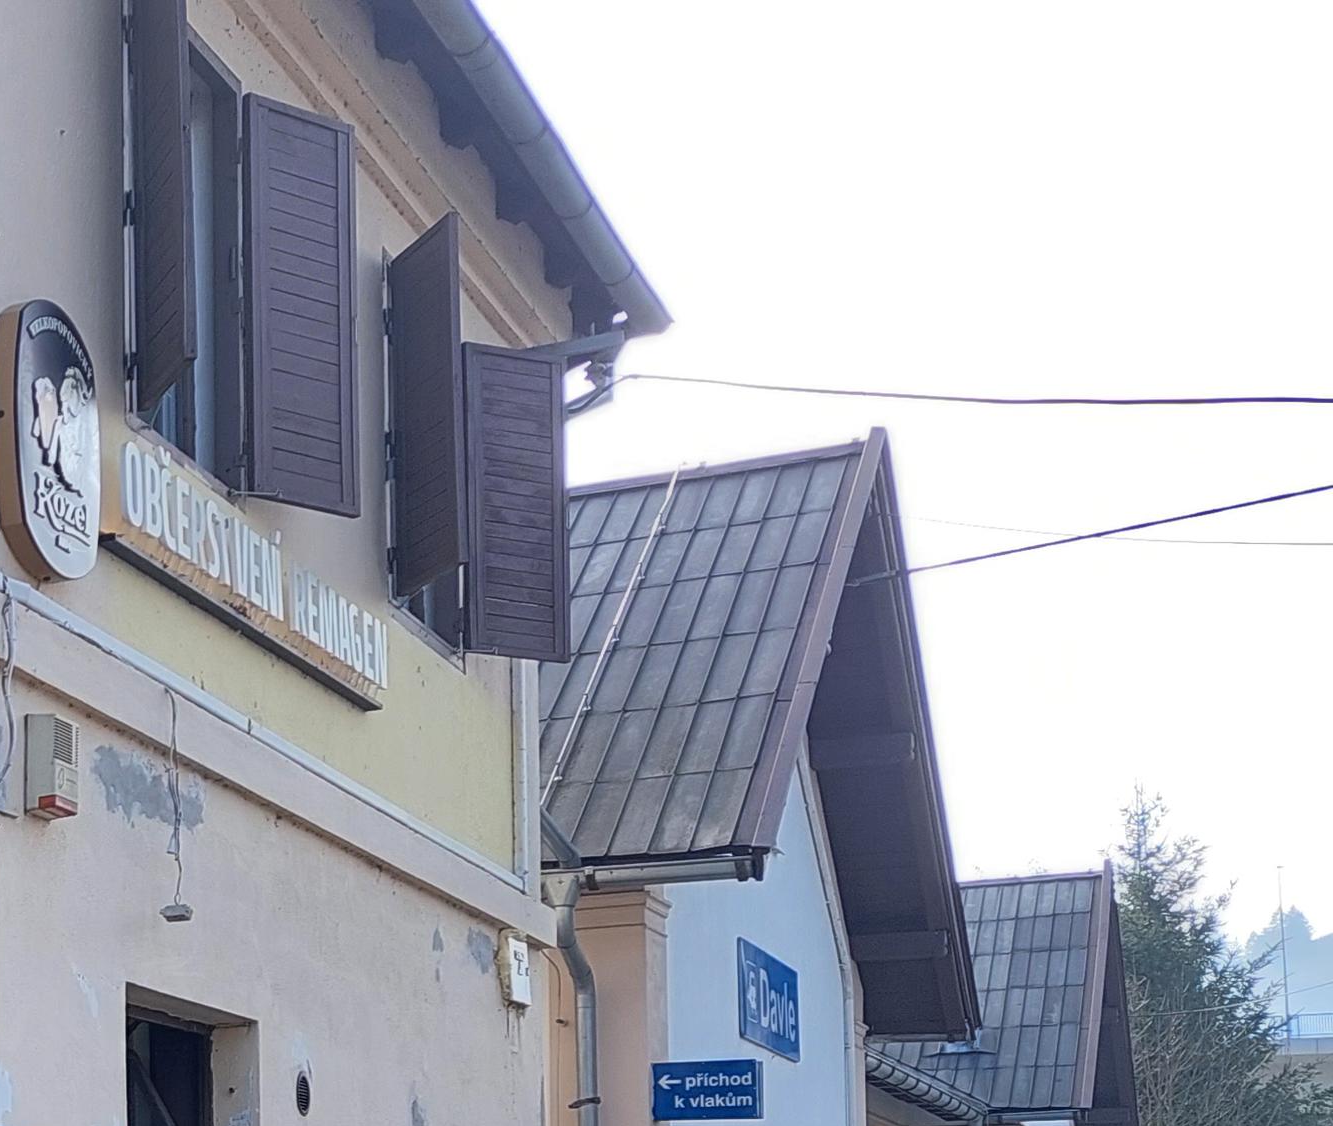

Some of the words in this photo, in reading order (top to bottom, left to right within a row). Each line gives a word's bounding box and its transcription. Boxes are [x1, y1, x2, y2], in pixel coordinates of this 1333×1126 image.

[124, 440, 284, 622] OBČERSTVENÍ
[290, 566, 388, 691] REMAGEN
[759, 967, 796, 1043] Davle
[674, 1095, 685, 1108] k
[689, 1092, 753, 1107] vlakům
[685, 1071, 753, 1091] příchod
